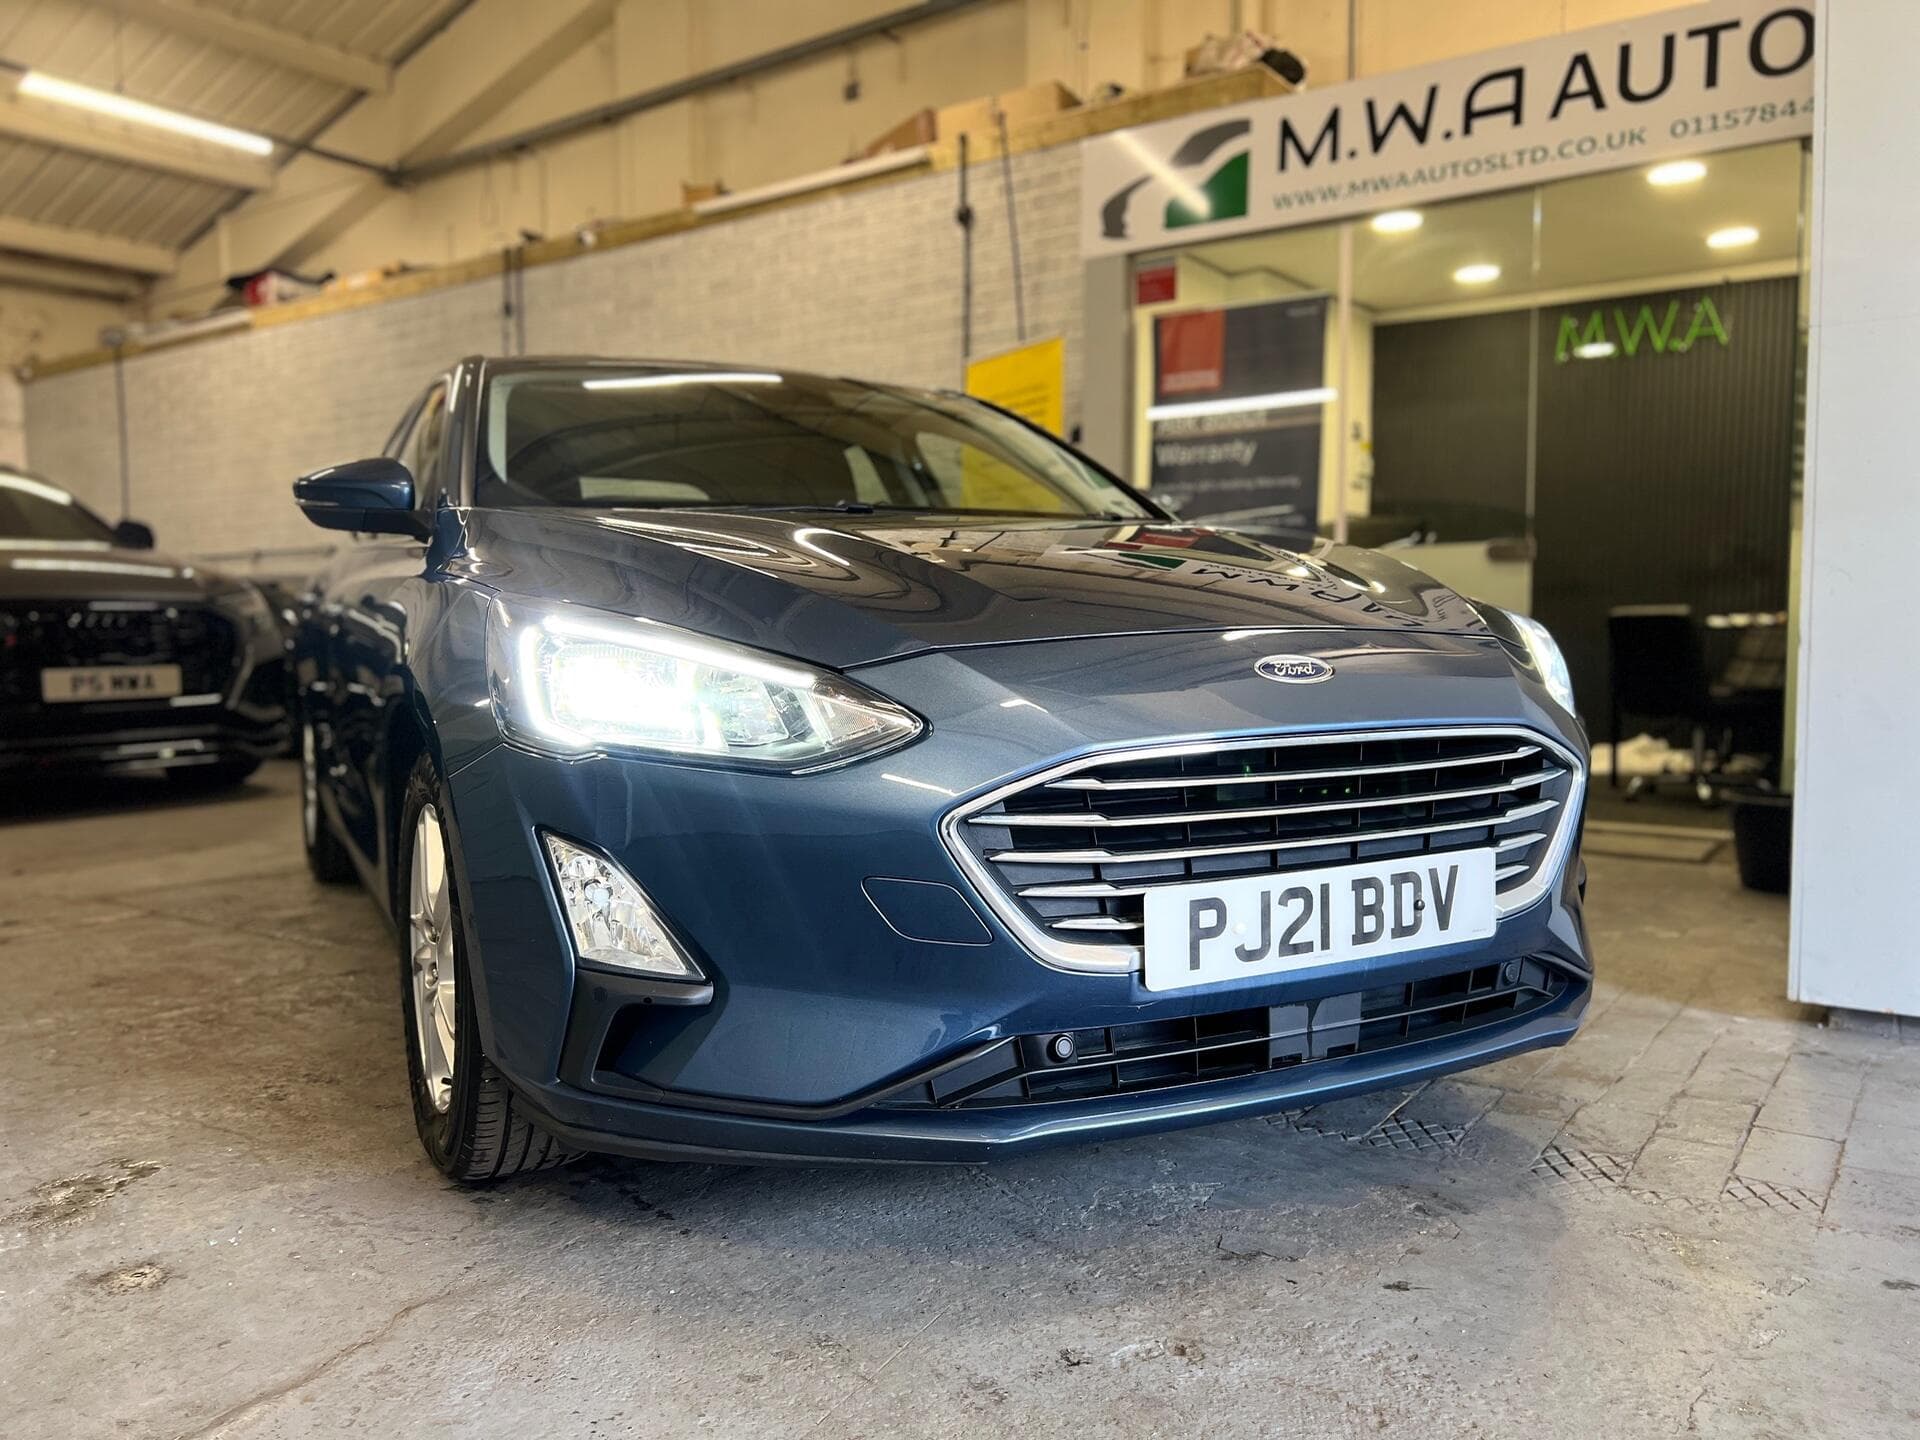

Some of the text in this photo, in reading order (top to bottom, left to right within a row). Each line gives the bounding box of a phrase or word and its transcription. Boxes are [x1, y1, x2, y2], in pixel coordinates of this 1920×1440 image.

[1277, 7, 1815, 173] M.W.A AUTO
[1272, 126, 1648, 211] WWW.MWAAUTOSLTD.CO.UK
[1269, 661, 1316, 676] Ford
[1188, 864, 1460, 971] PJ21 BDV
